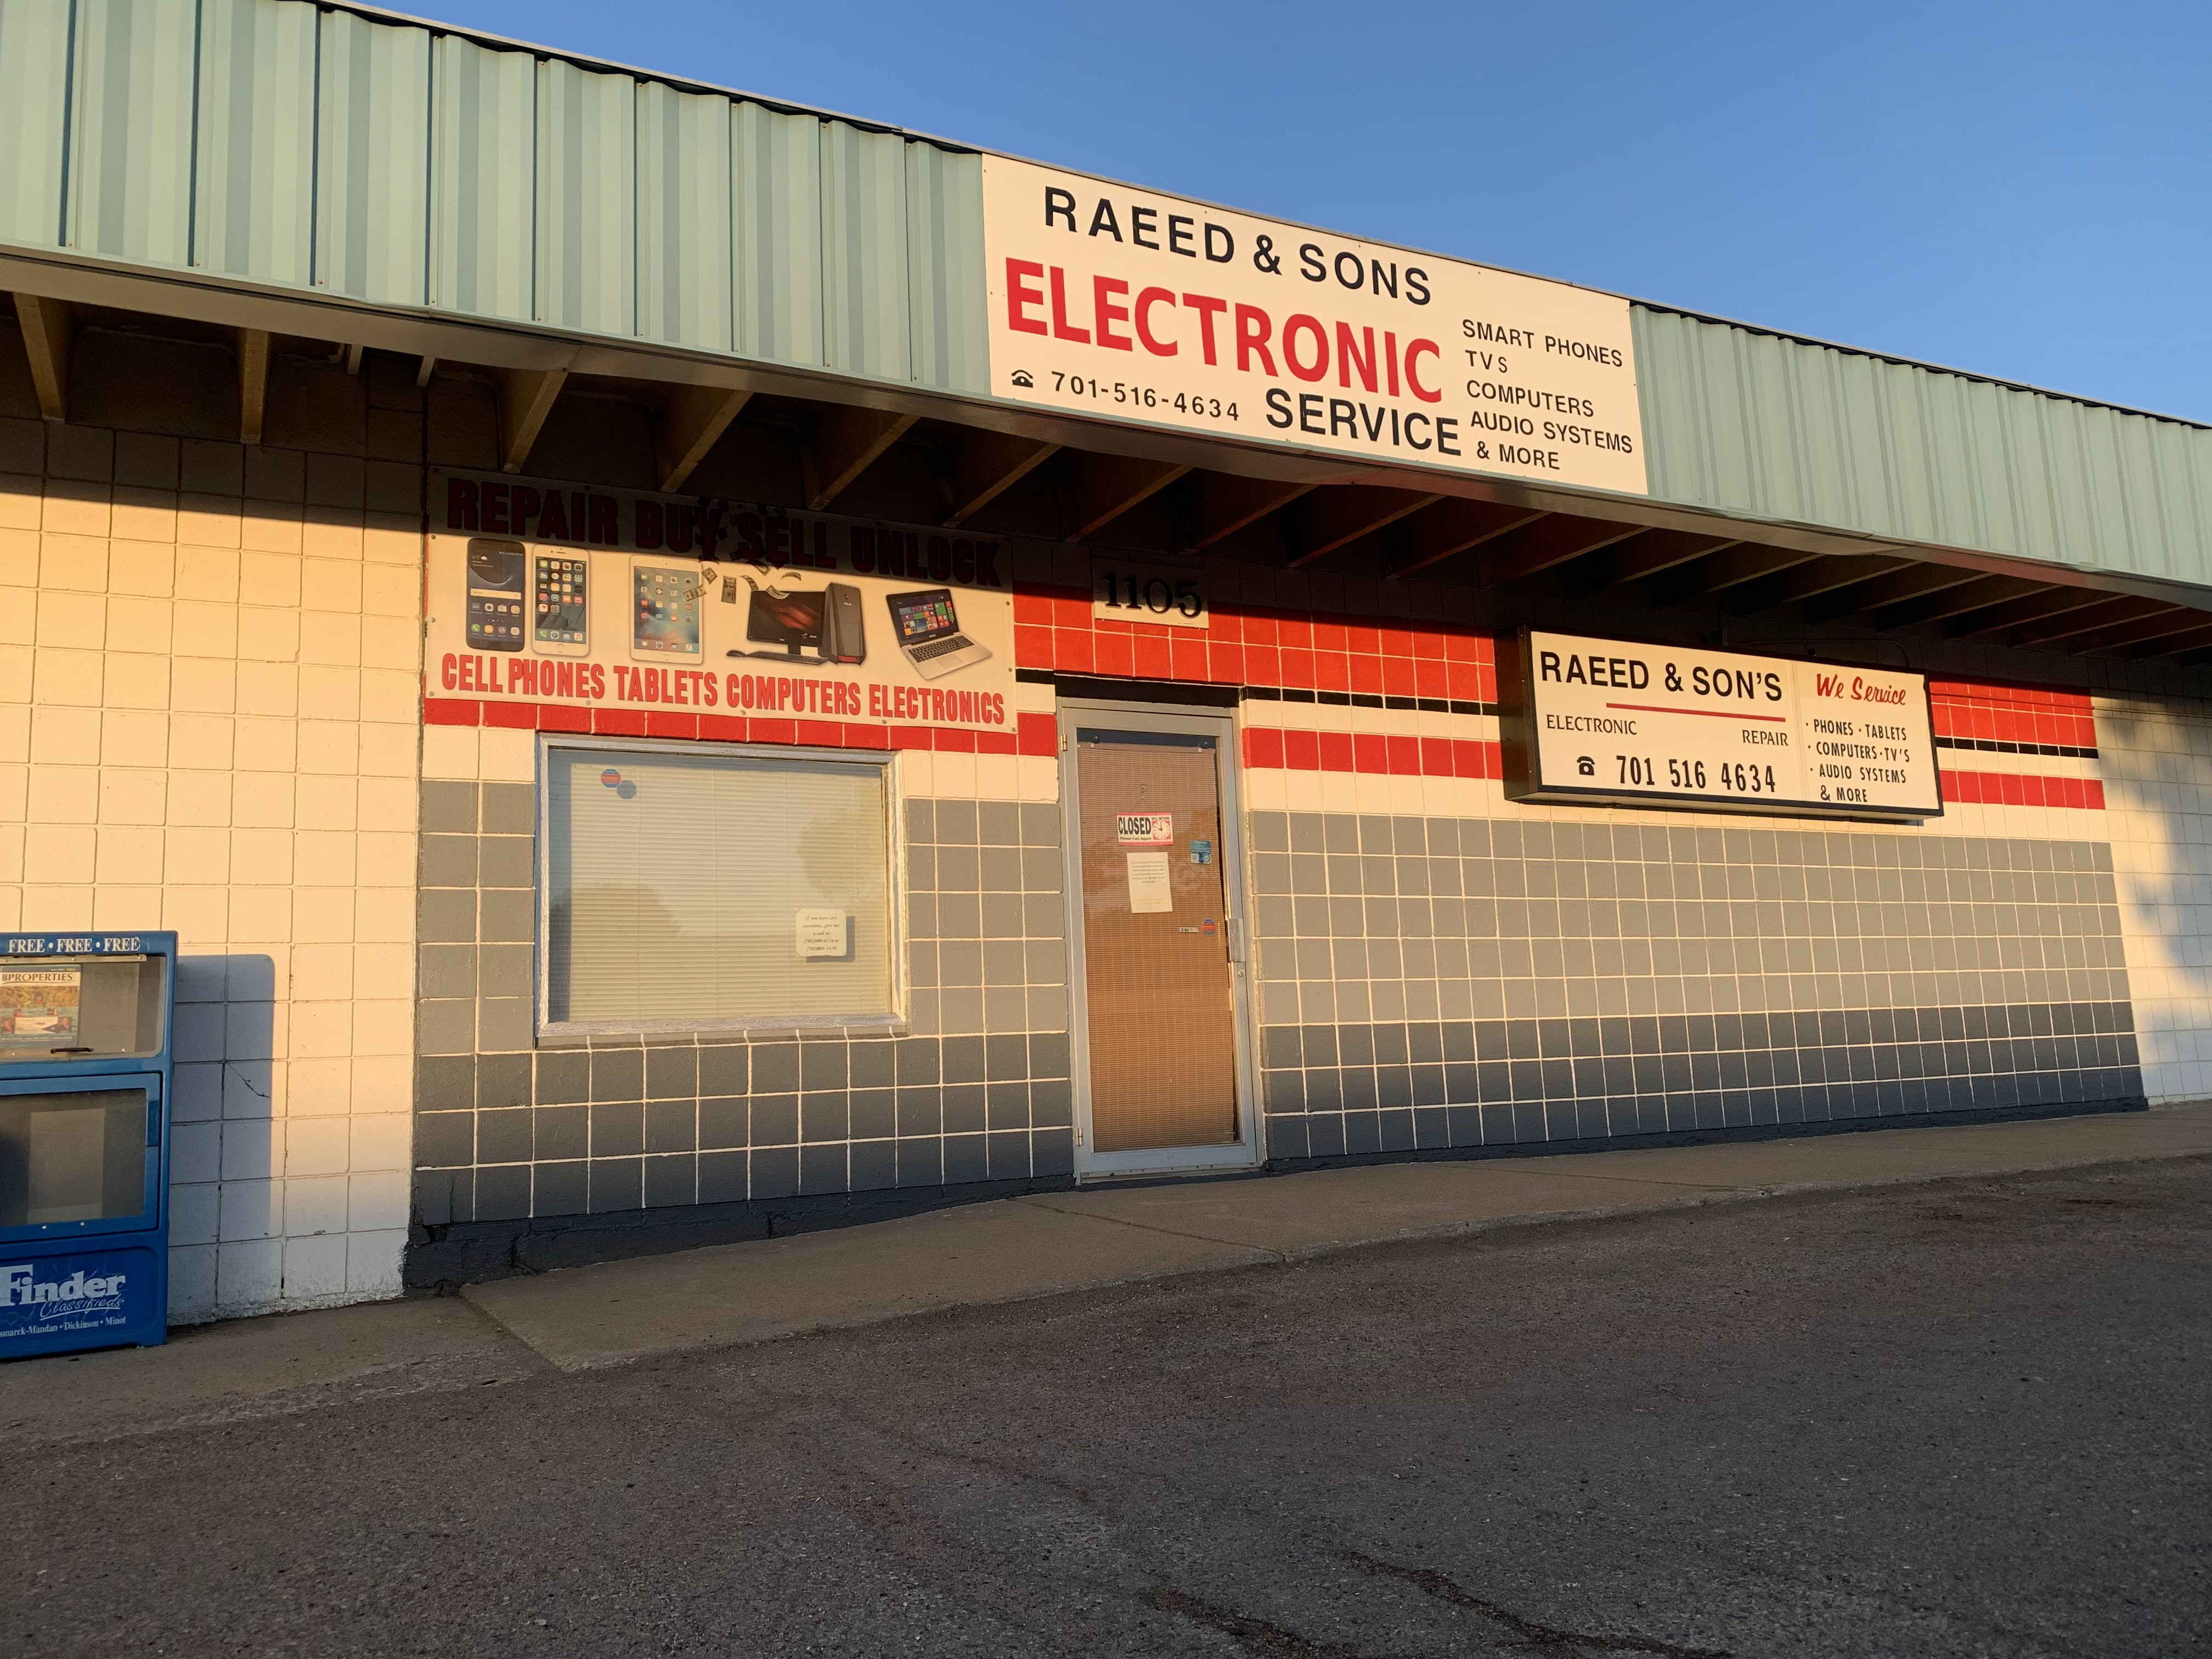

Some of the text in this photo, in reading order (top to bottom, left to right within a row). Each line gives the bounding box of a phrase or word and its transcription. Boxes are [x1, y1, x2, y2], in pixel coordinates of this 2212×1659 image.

[1045, 187, 1431, 306] RAEED & SONS
[1006, 257, 1442, 403] ELECTRONIC
[1463, 319, 1622, 368] SMART PHONES
[1051, 371, 1239, 421] 701-516-4634
[1467, 380, 1594, 417] COMPUTERS
[1266, 388, 1461, 456] SERVICE
[1471, 410, 1632, 454] AUDIO SYSTEMS
[1477, 441, 1560, 470] & MORE
[447, 477, 1001, 588] REPAIR BUY SELL UNLOCK
[1102, 573, 1203, 619] 1105
[442, 653, 1005, 725] CELL PHONES TABLETS COMPUTERS ELECTRONICS
[1540, 651, 1782, 701] RAEED & SON'S
[1816, 673, 1906, 706] We Service
[1547, 715, 1788, 746] ELECTRONIC REPAIR
[1814, 719, 1906, 741] PHONES TABLETS
[1816, 742, 1909, 763] COMPUTERS TV'S
[1617, 755, 1775, 792] 701 516 4634
[1819, 763, 1906, 784] AUDIO SYSTEMS
[1820, 785, 1867, 803] & MORE
[1118, 817, 1151, 835] CLOSED
[8, 937, 140, 953] FREE FREE FREE
[8, 973, 73, 982] PROPERTIES
[0, 1264, 126, 1307] Finder
[64, 1319, 99, 1330] Dickinson
